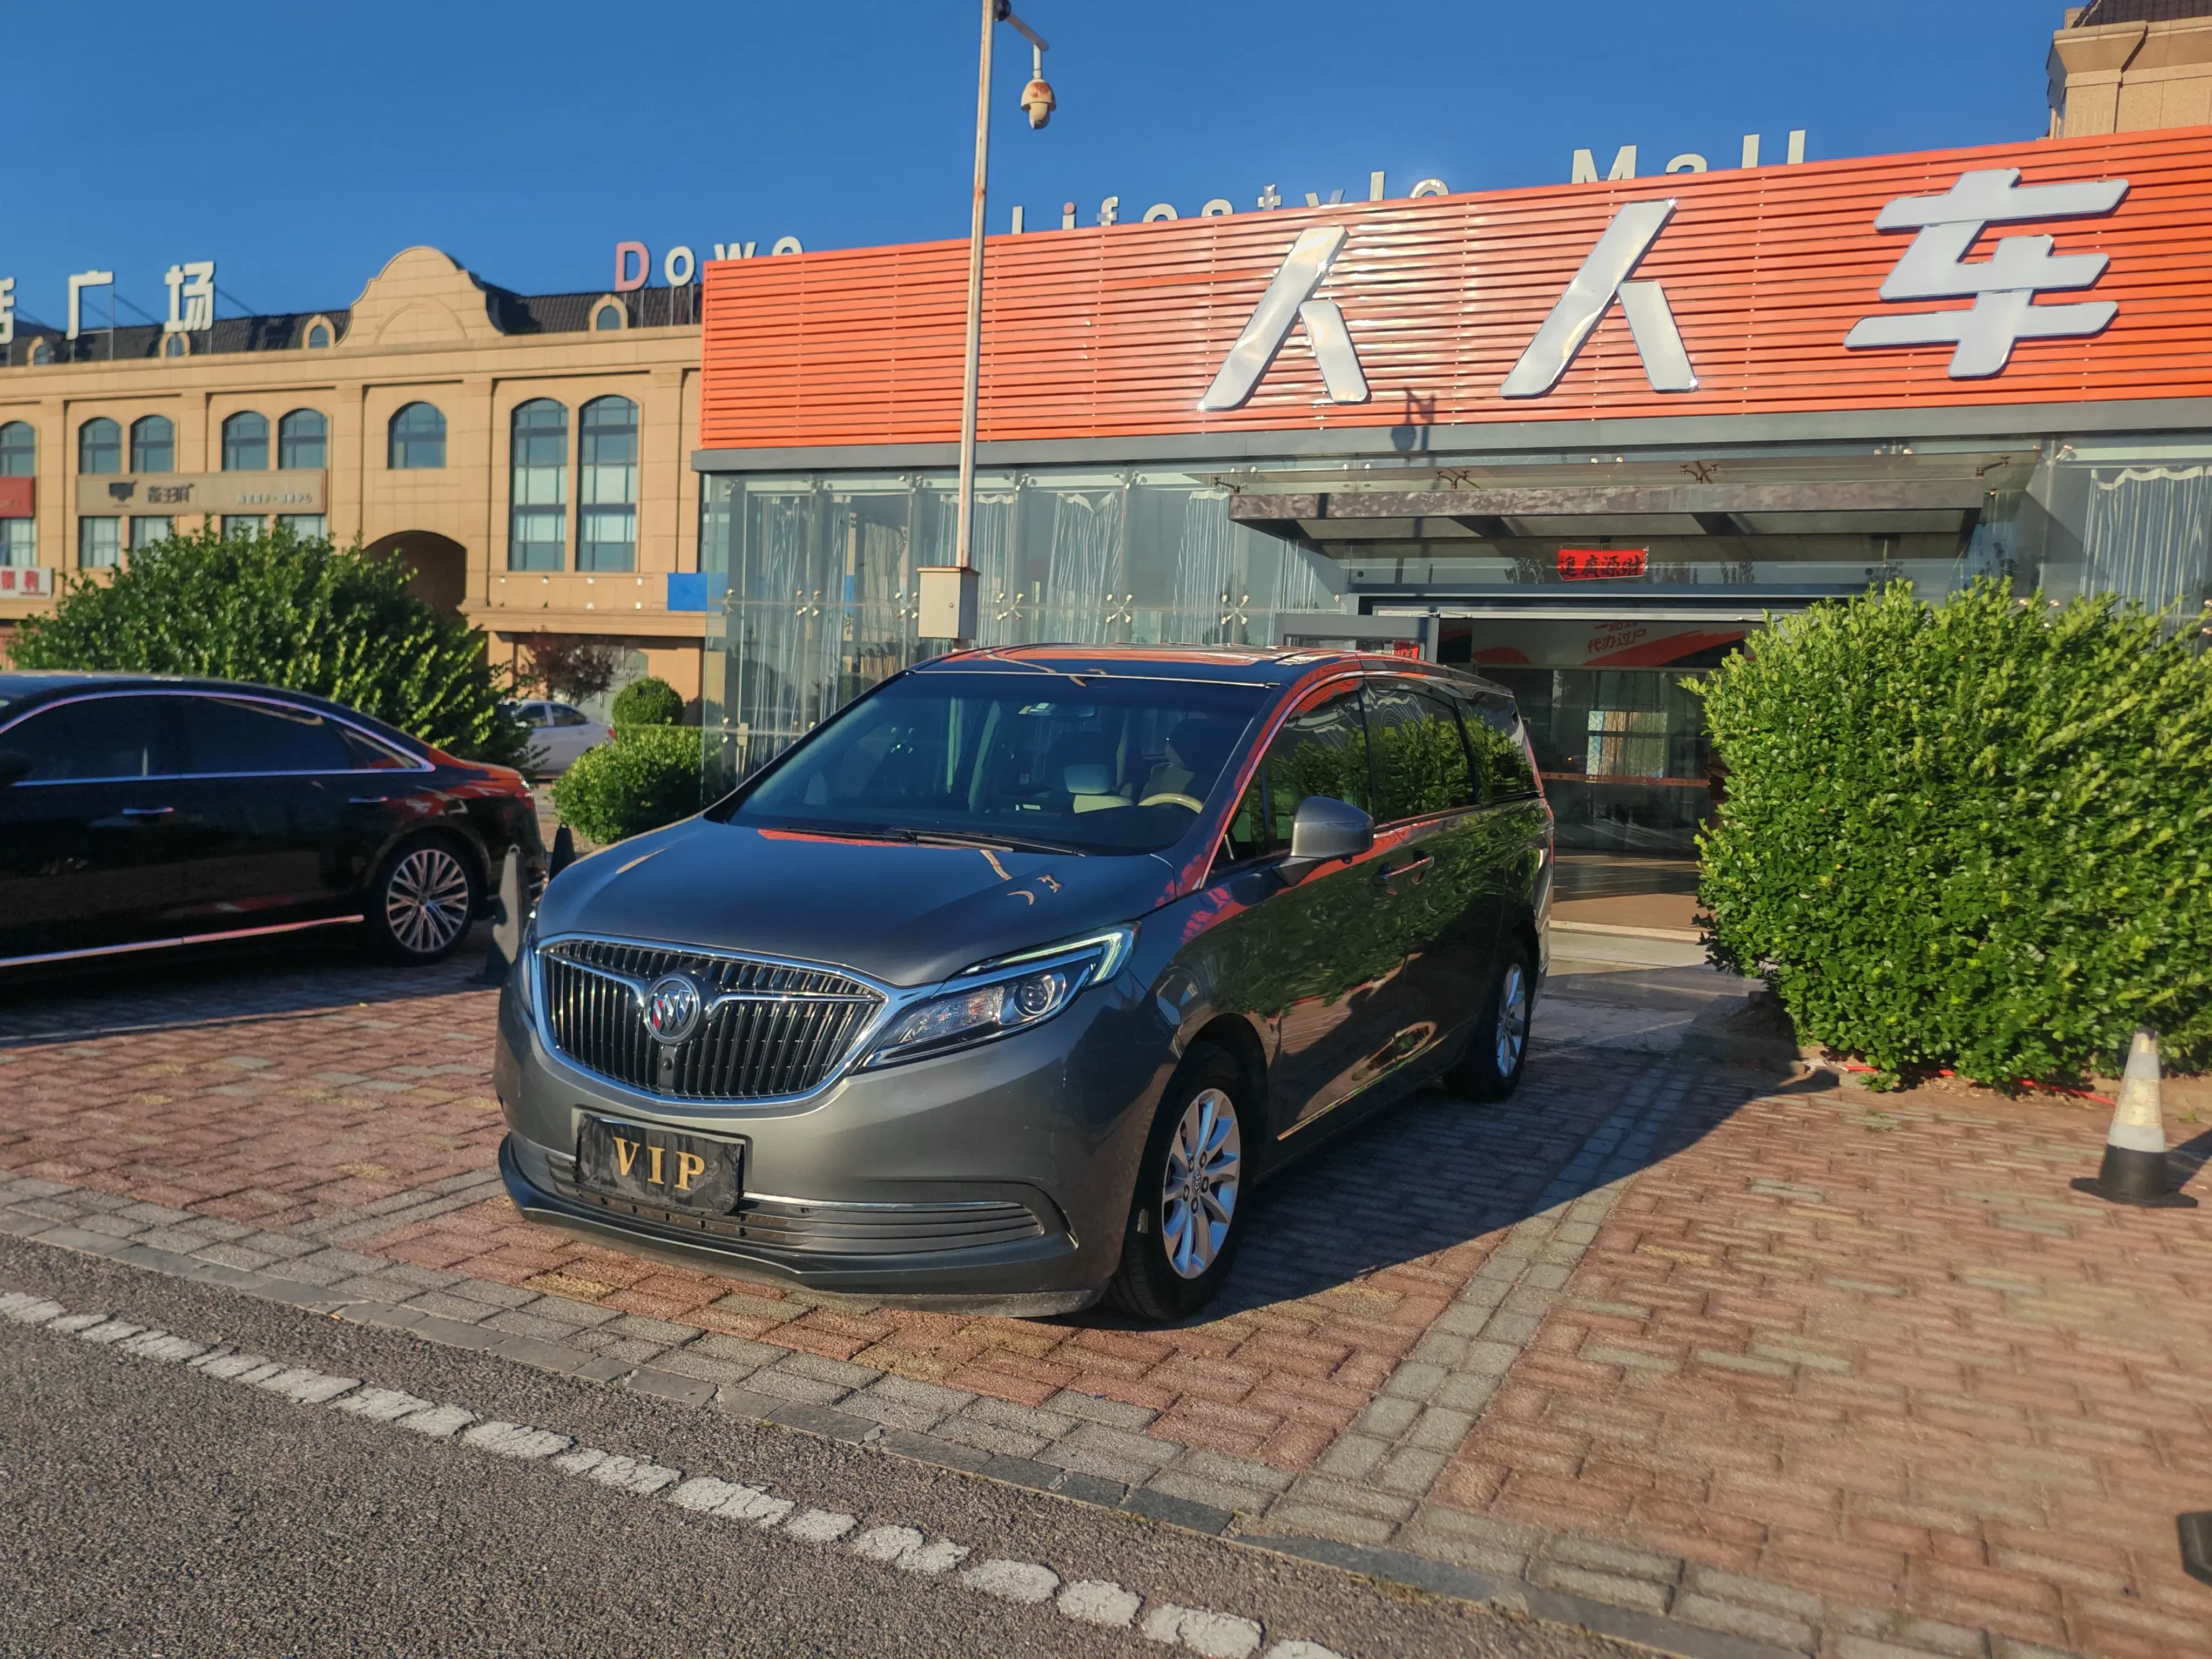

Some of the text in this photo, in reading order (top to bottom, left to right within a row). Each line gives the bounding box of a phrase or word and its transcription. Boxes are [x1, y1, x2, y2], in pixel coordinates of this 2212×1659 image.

[1196, 167, 2129, 410] 人人车
[1587, 628, 1647, 653] 代办过户
[613, 1136, 705, 1191] VIP
